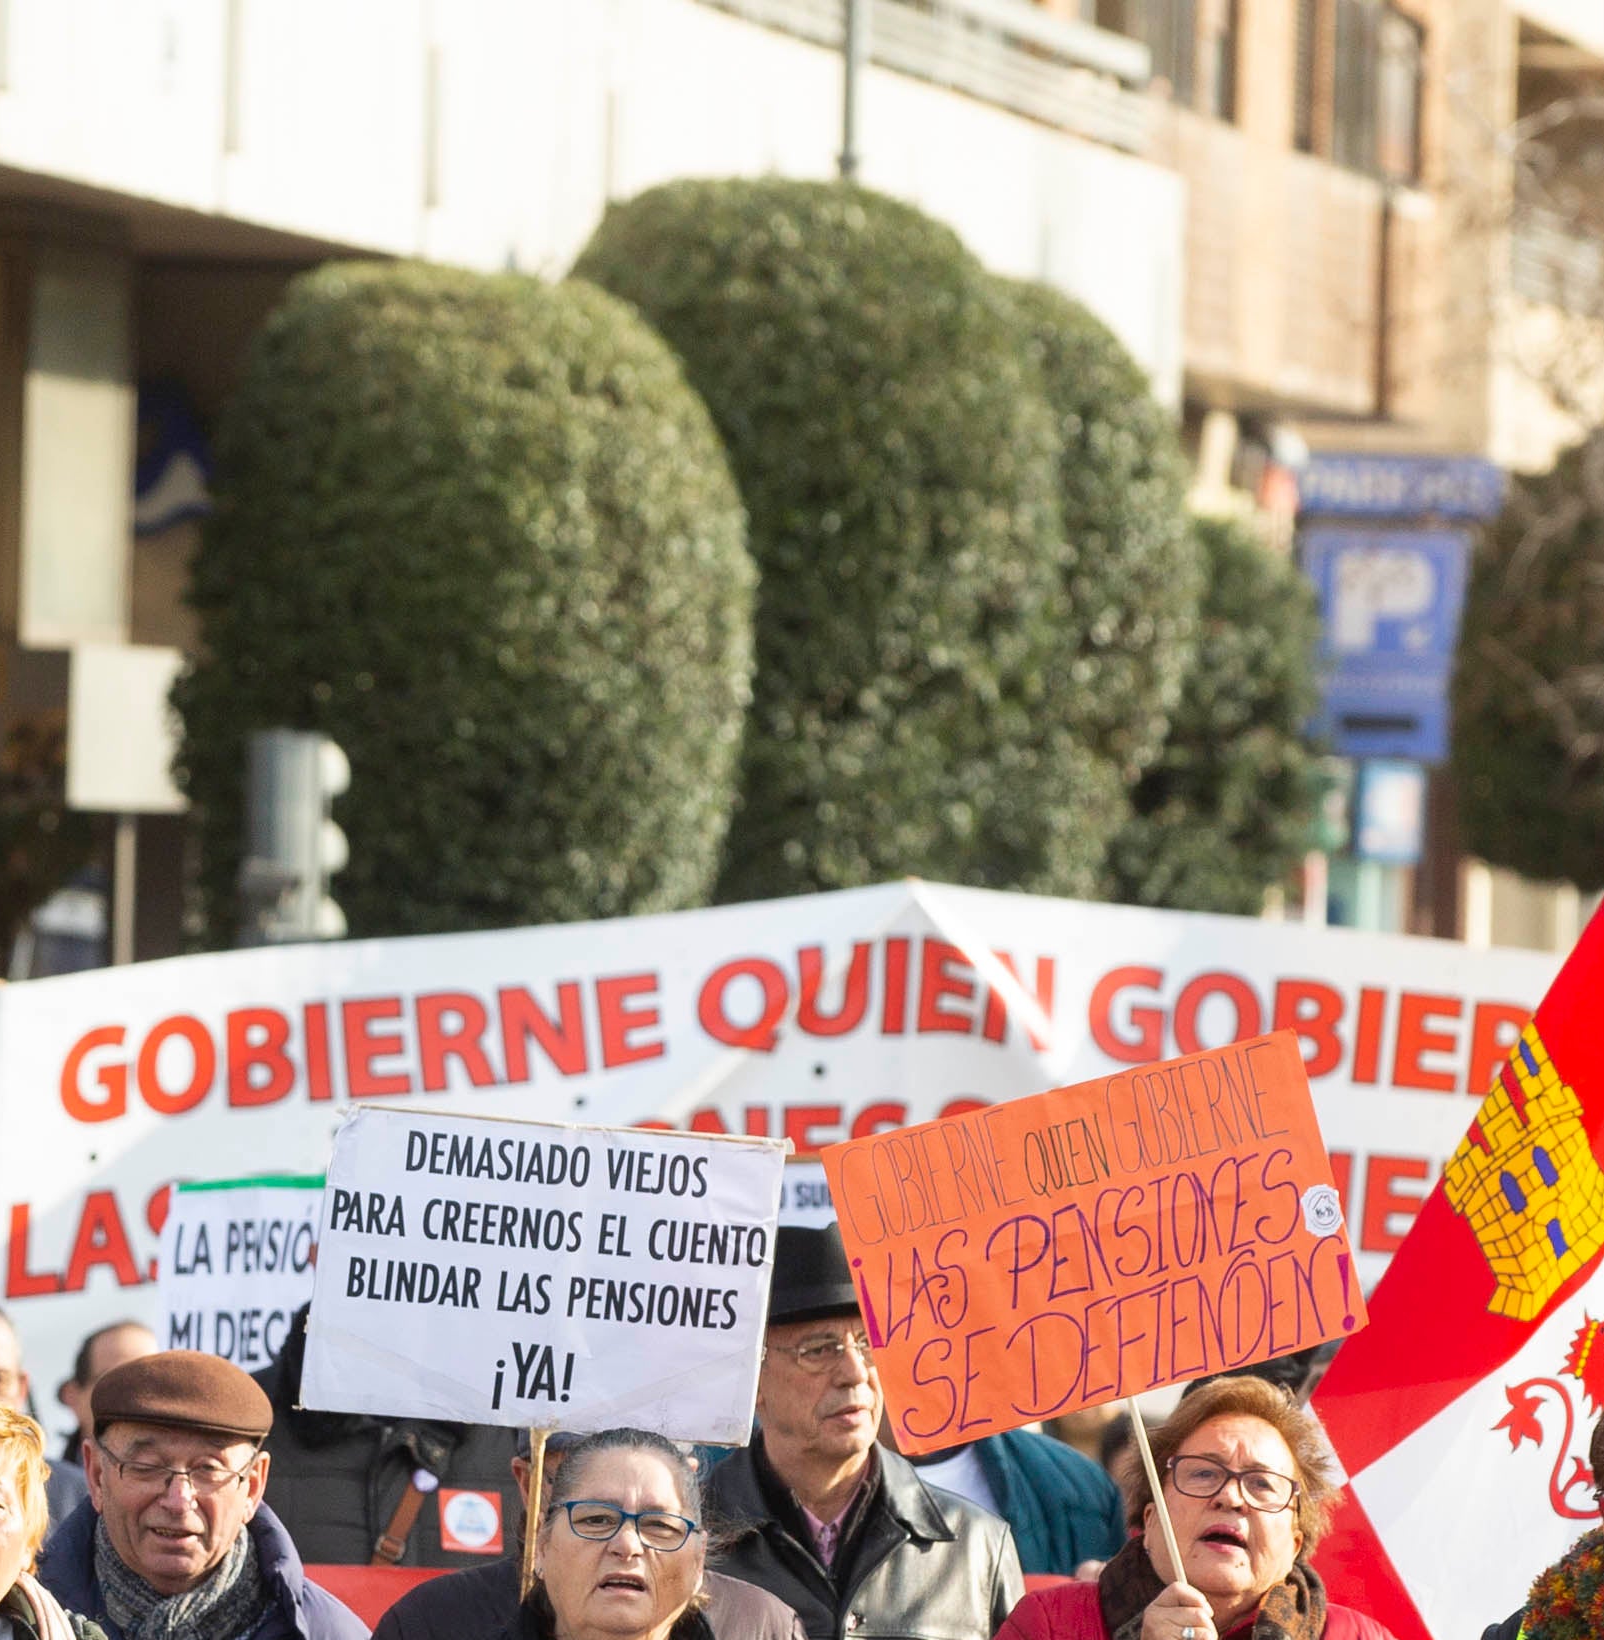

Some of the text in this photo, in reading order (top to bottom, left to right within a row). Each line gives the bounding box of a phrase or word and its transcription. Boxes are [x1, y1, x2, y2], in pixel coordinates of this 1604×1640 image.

[60, 972, 665, 1125] GOBIERNE
[697, 934, 1055, 1053] QUIEN
[406, 1129, 591, 1187] DEMASIADO
[607, 1148, 709, 1198] VIEJOS
[840, 1042, 1290, 1246] GOBIERNE QUIEN GOBIERNE
[175, 1221, 213, 1275] LA
[330, 1189, 768, 1267] PARA CREERNOS EL CUENTO
[985, 1149, 1301, 1311] PENSIONES
[346, 1256, 739, 1331] BLINDAR LAS PENSIONES
[902, 1327, 997, 1439] SE
